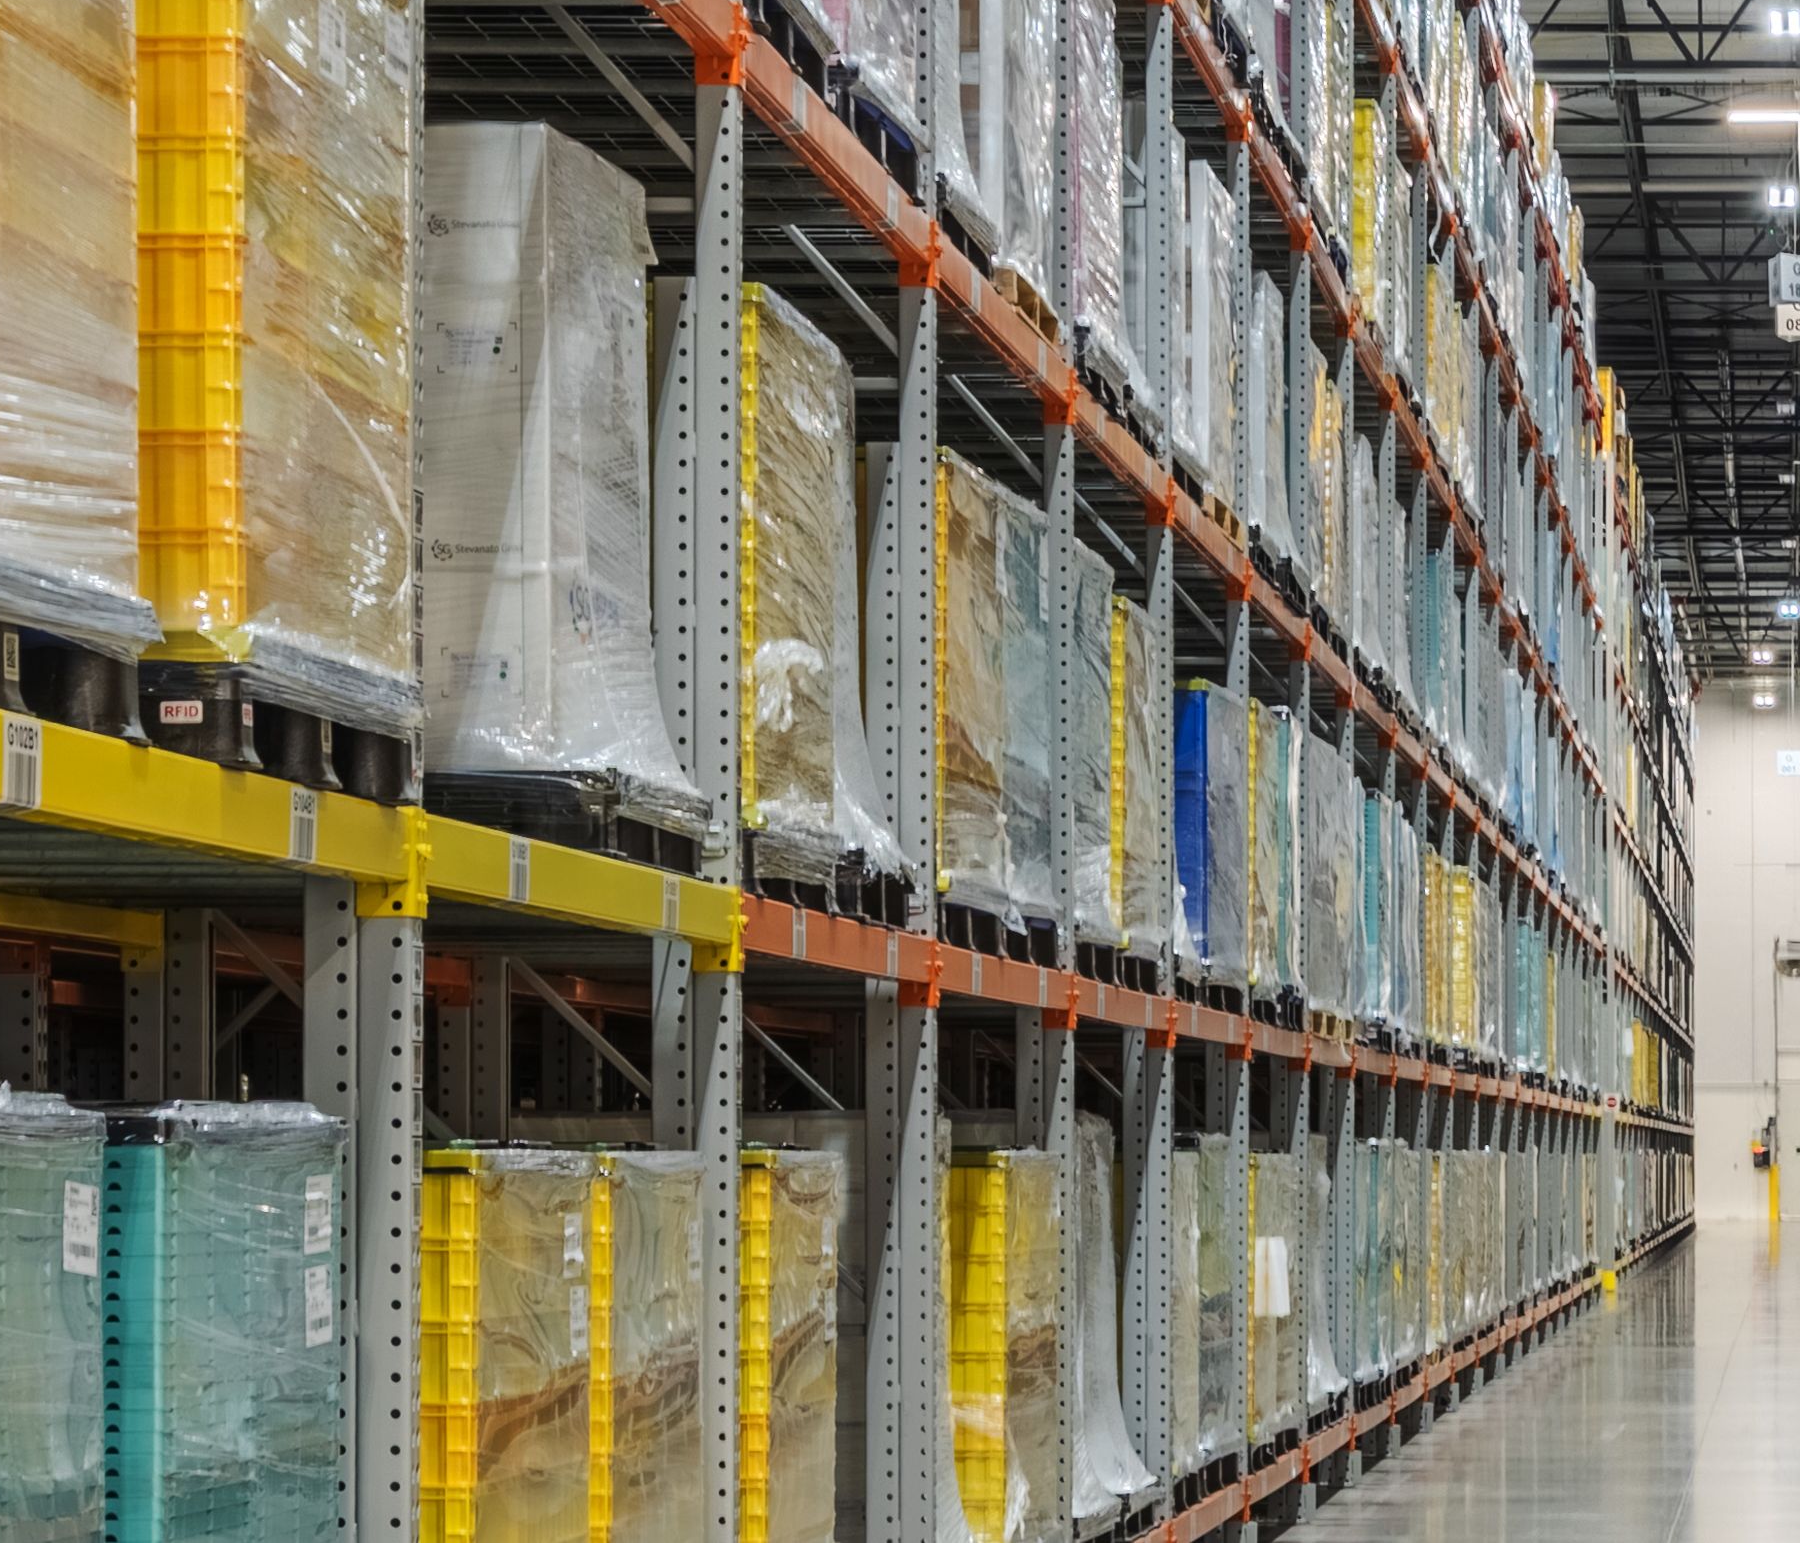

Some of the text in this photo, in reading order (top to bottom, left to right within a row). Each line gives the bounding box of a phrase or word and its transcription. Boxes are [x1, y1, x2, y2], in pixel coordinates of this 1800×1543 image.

[455, 544, 499, 553] Stevanato
[165, 705, 199, 718] RFID
[8, 724, 39, 751] G102B1
